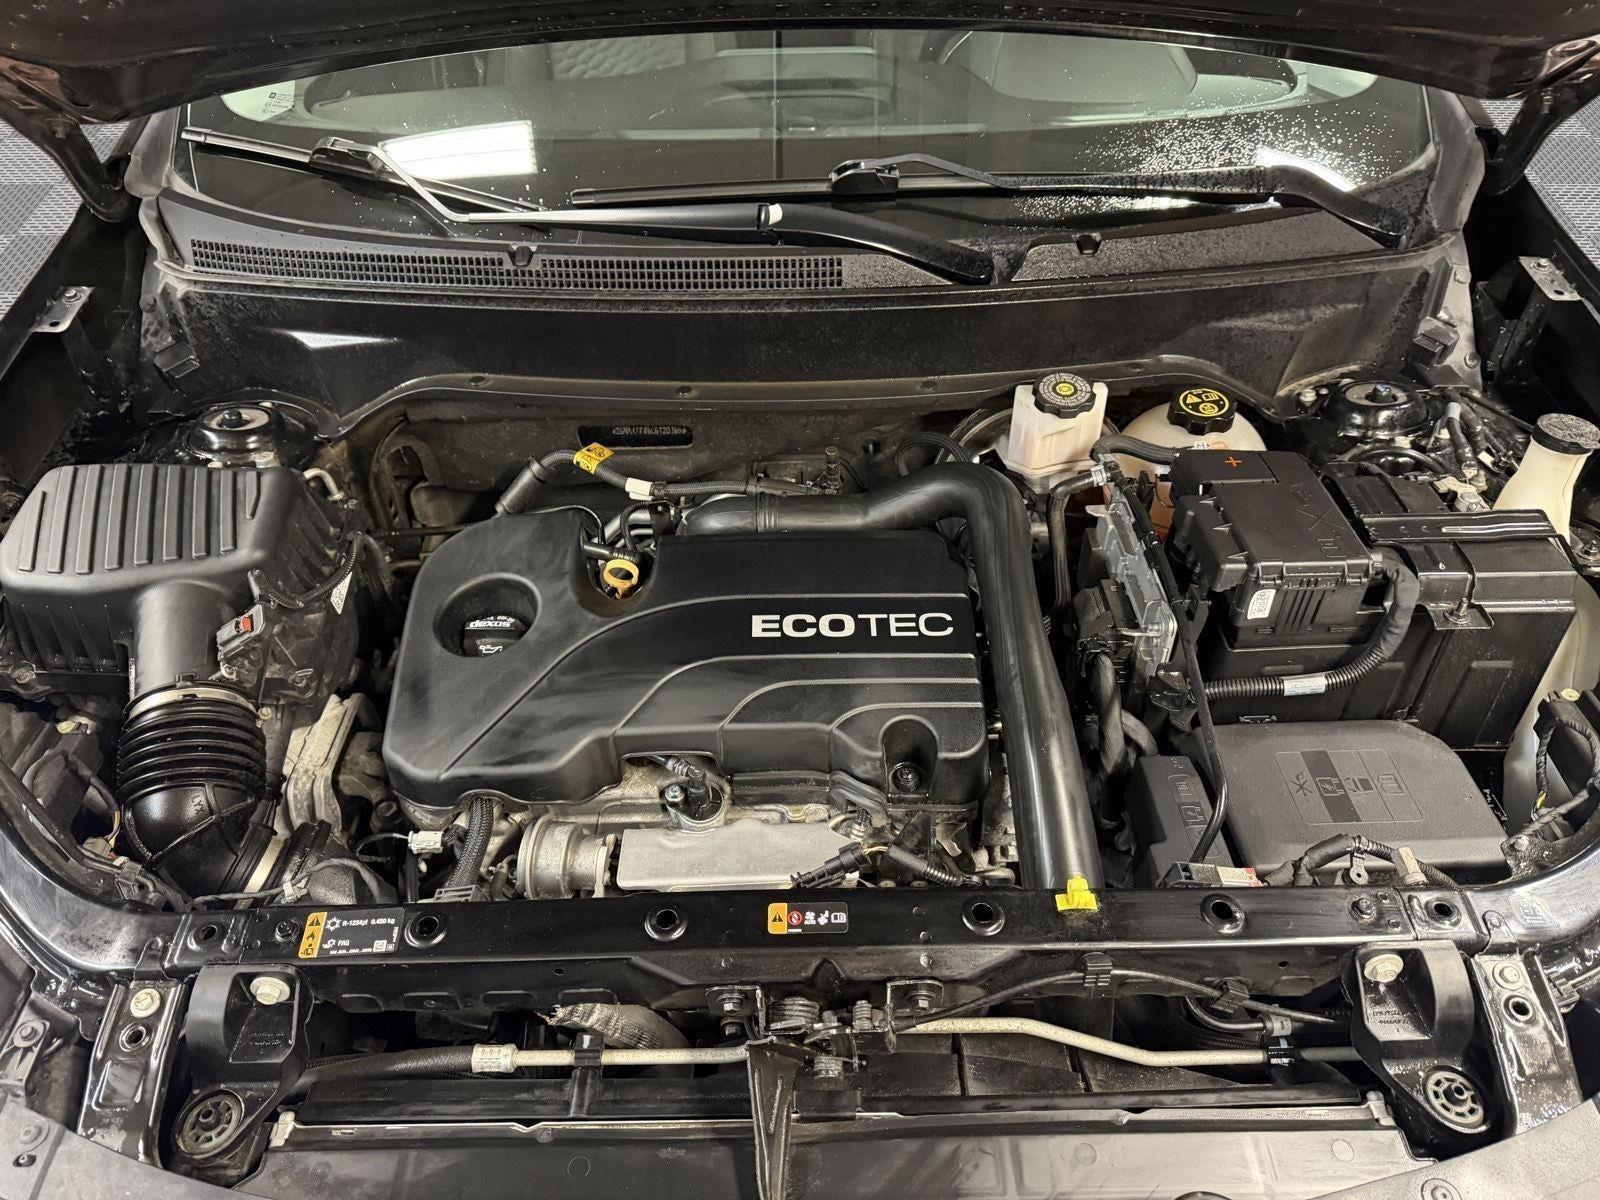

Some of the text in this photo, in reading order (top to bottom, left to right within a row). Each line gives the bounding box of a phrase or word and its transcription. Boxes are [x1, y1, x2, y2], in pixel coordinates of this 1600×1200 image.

[469, 619, 511, 628] dexos
[751, 612, 954, 638] ECOTEC
[387, 917, 395, 925] kg
